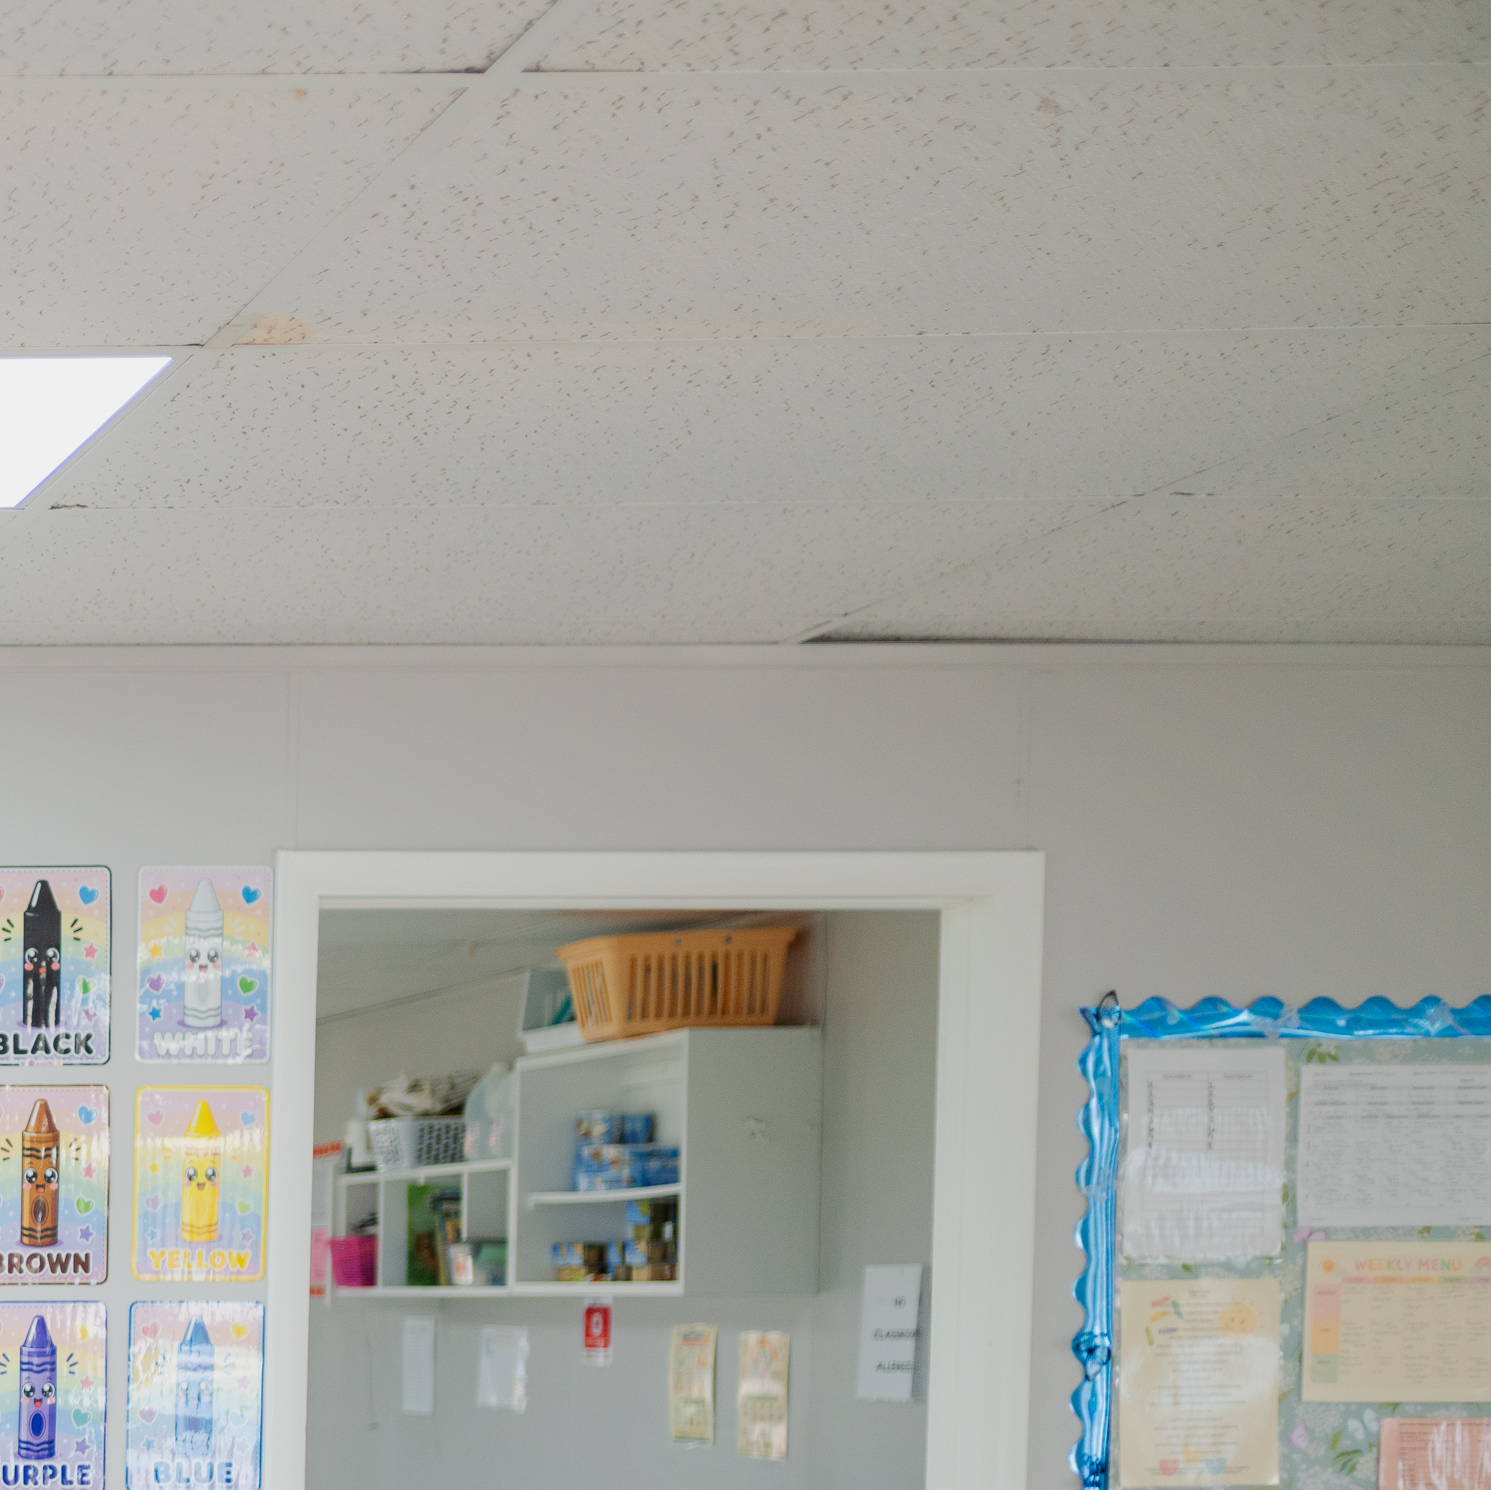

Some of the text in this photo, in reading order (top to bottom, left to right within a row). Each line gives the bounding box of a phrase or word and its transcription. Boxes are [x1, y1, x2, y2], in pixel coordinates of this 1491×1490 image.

[154, 1030, 254, 1056] WHITE
[148, 1251, 251, 1271] YELLOW
[1355, 1258, 1462, 1271] WEEKLY MENU
[153, 1461, 234, 1484] BLUE
